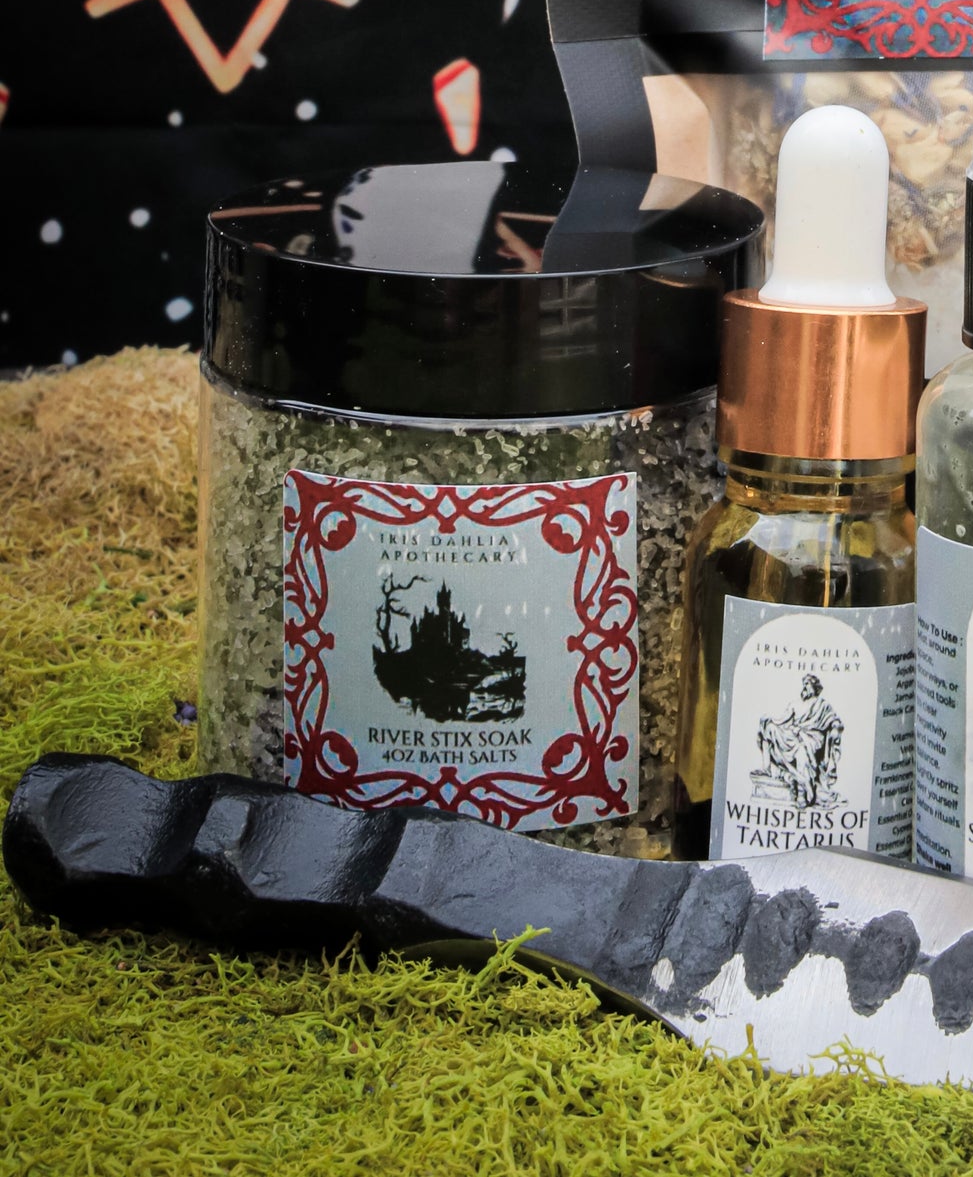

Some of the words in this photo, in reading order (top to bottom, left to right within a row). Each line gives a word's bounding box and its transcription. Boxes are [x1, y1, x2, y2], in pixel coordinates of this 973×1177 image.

[379, 533, 419, 546] IRIS
[432, 535, 510, 547] DAHLIA
[380, 550, 517, 563] APOTHECARY
[931, 623, 940, 636] To
[941, 629, 958, 644] Use
[756, 643, 788, 655] IRIS
[798, 647, 860, 658] DAHLIA
[753, 657, 861, 672] APOTHECARY
[368, 728, 427, 747] RIVER
[431, 731, 473, 748] STIX
[479, 728, 532, 747] SOAK
[420, 750, 464, 765] BATH
[469, 750, 517, 765] SALTS
[727, 801, 834, 830] WHISPERS
[841, 810, 868, 830] OF
